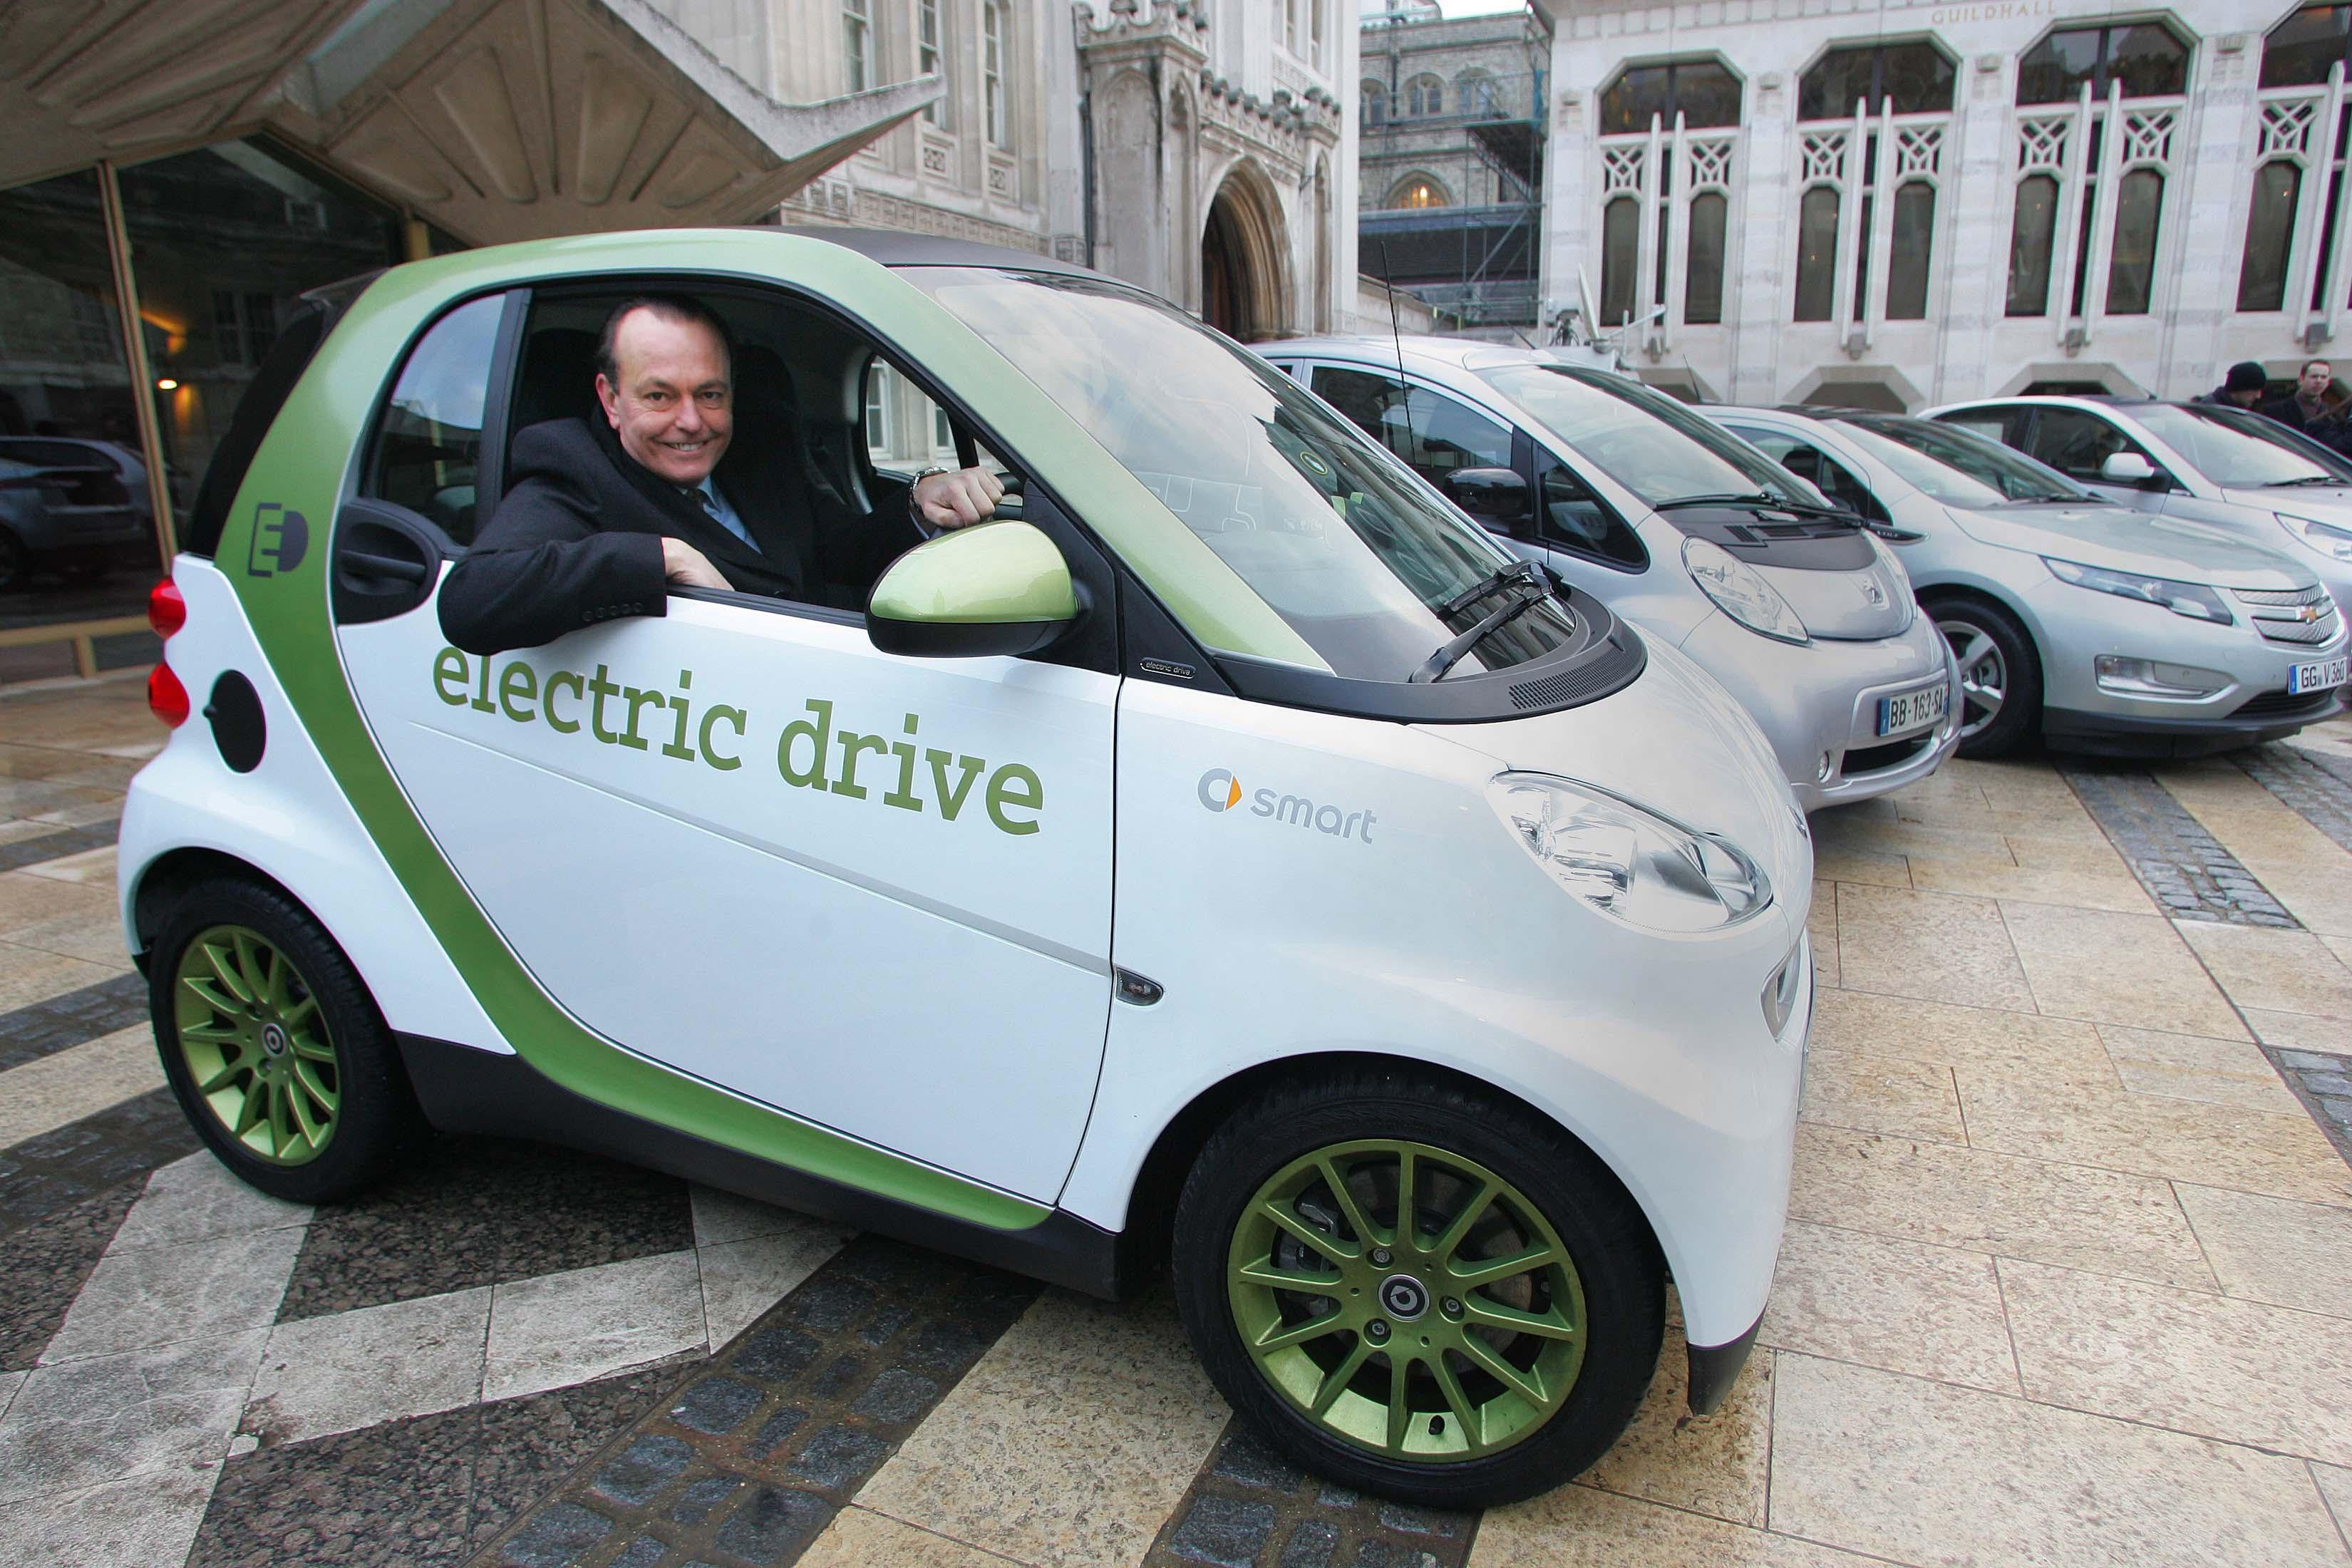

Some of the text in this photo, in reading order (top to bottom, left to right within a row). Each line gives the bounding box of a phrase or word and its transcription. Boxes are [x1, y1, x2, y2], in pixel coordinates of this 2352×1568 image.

[1931, 1, 2056, 25] GUILDHALL
[2301, 666, 2316, 688] GG
[2324, 664, 2330, 684] V
[1890, 688, 1943, 728] BB-163-SA
[433, 646, 1043, 835] electric drive
[1249, 788, 1377, 844] smart
